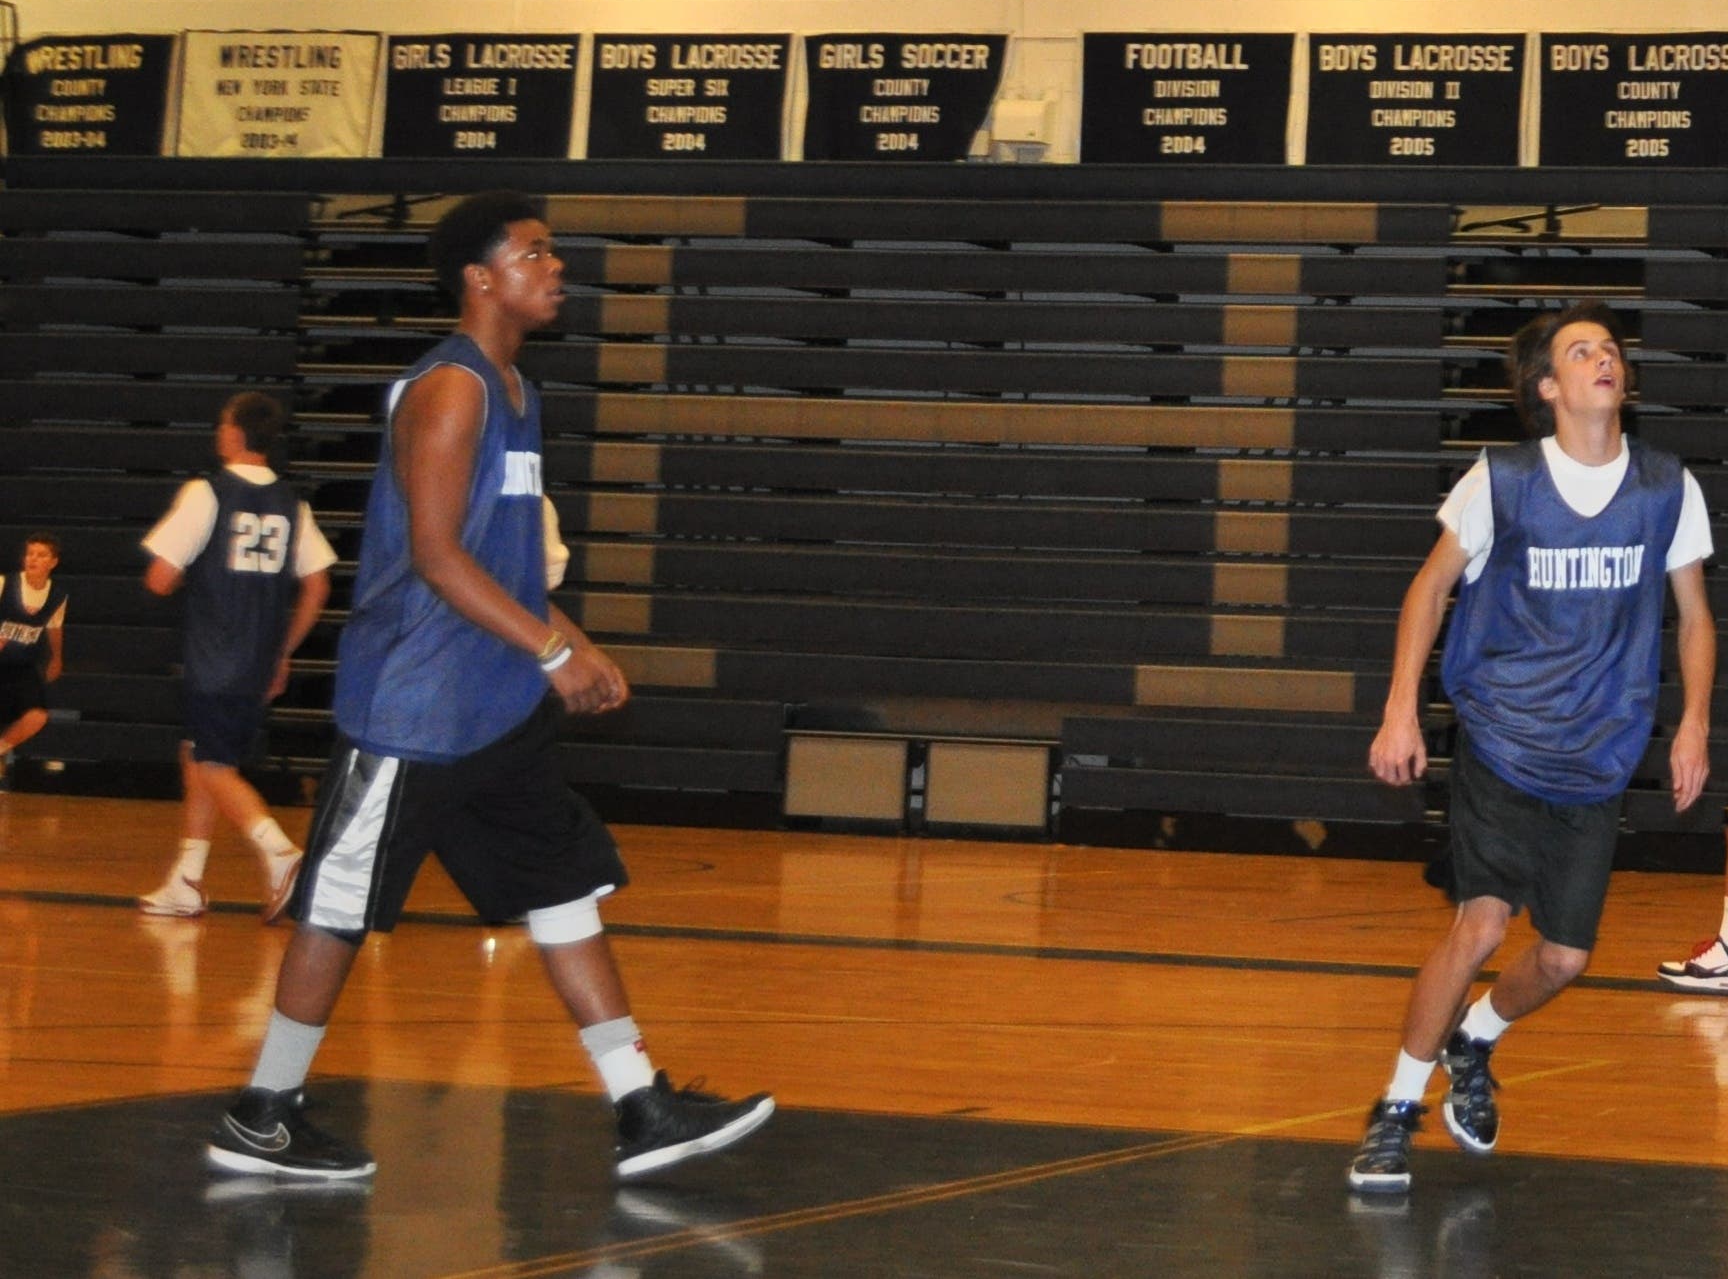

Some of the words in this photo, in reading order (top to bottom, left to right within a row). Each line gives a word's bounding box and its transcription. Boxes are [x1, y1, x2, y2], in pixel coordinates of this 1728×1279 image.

[25, 44, 144, 74] WRESTLING
[219, 45, 342, 69] WRESTLING
[392, 43, 451, 70] GIRLS
[465, 43, 575, 69] LACROSSE
[600, 44, 656, 69] BOYS
[672, 43, 783, 70] LACROSSE
[818, 44, 885, 70] GIRLS
[901, 44, 990, 70] SOCCER
[1125, 43, 1249, 70] FOOTBALL
[1318, 44, 1377, 72] BOYS
[1394, 44, 1515, 72] LACROSSE
[1551, 44, 1609, 72] BOYS
[299, 79, 341, 98] STATE
[443, 78, 499, 96] LEAGUE
[646, 78, 696, 97] SUPER
[704, 78, 730, 97] SIX
[873, 79, 930, 97] COUNTY
[1153, 79, 1221, 98] DIVISION
[1369, 80, 1434, 99] DIVISION
[1617, 81, 1681, 100] COUNTY
[439, 104, 518, 122] CHAMPIONS
[646, 106, 727, 124] CHAMPIONS
[860, 106, 940, 124] CHAMPIONS
[1142, 107, 1228, 126] CHAMPIONS
[1371, 109, 1456, 128] CHAMPIONS
[1604, 110, 1692, 129] CHAMPIONS
[1625, 139, 1670, 158] 2005
[228, 512, 290, 573] 23
[1527, 544, 1645, 590] HUNTINGTON
